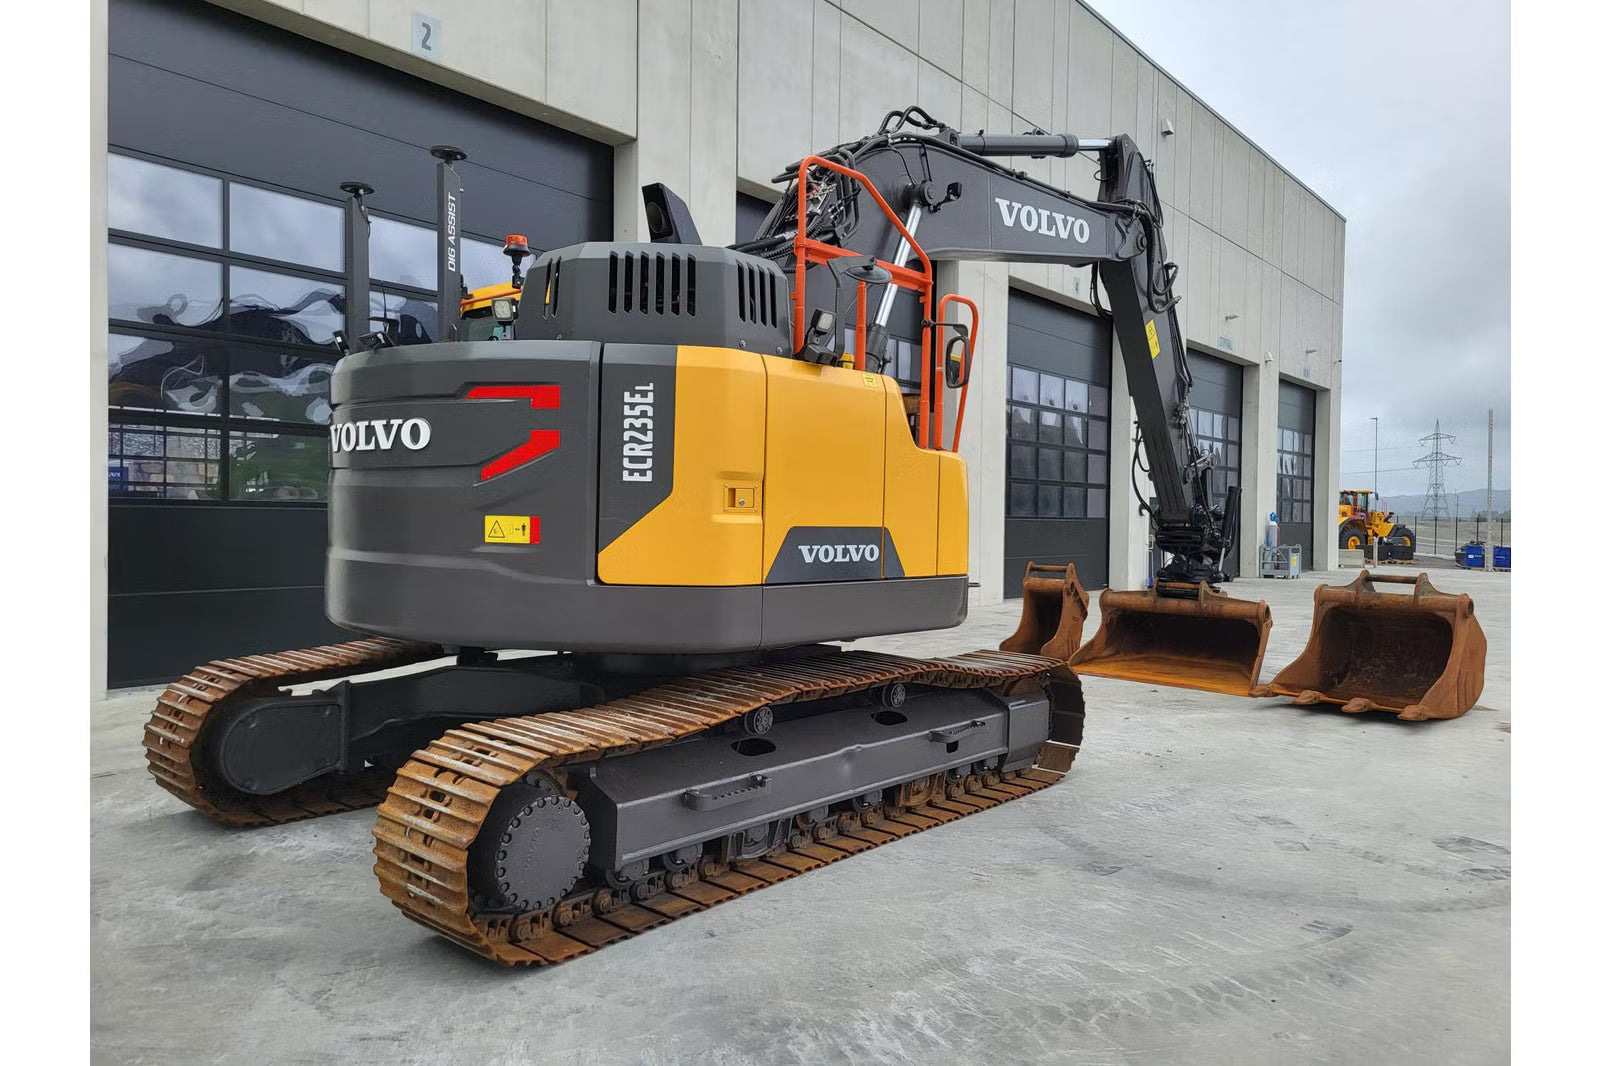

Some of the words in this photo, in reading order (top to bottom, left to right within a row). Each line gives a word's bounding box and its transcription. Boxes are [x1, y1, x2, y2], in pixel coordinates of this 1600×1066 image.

[421, 22, 432, 51] 2
[448, 192, 456, 246] ASSIST
[995, 197, 1090, 244] VOLVO
[448, 247, 456, 272] DIG
[330, 417, 431, 452] VOLVO
[798, 544, 880, 563] VOLVO
